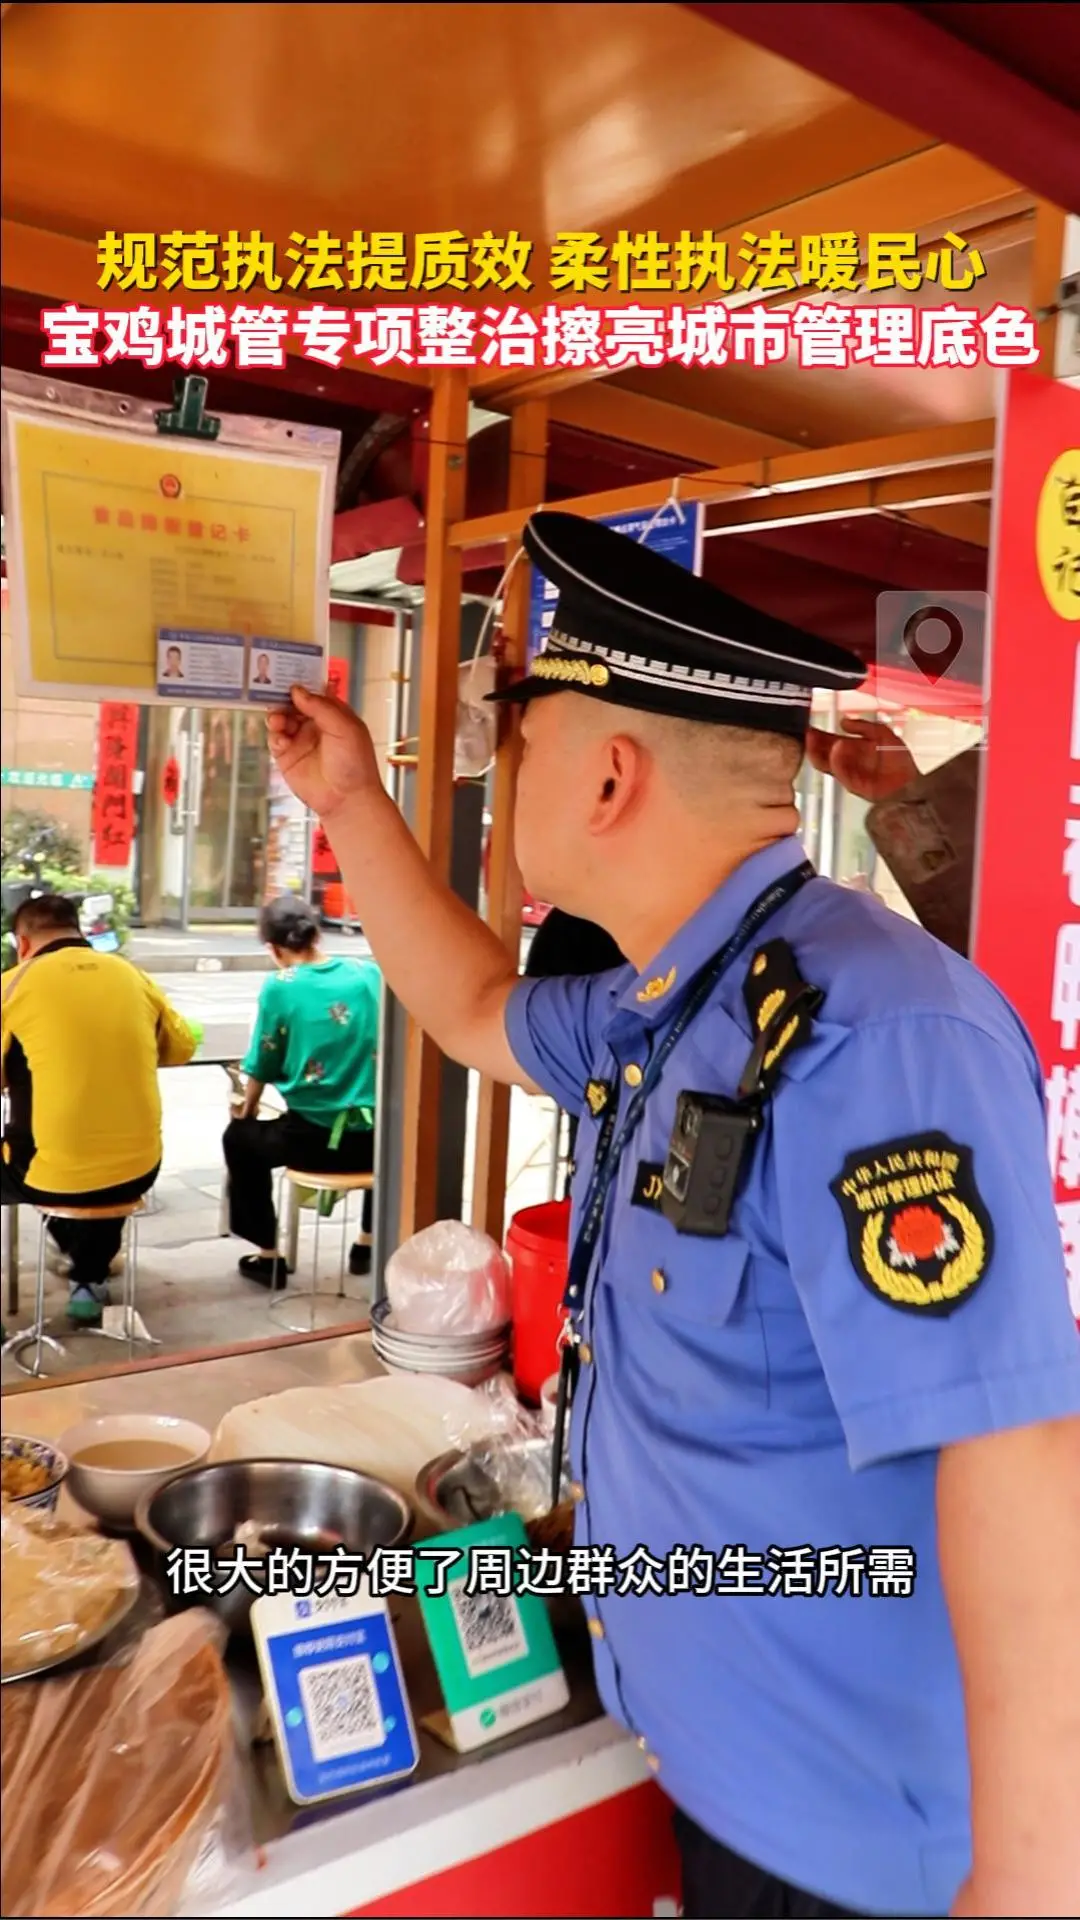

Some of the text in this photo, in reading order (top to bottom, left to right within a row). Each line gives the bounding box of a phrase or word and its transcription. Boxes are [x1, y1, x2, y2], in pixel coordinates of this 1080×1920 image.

[841, 1149, 960, 1197] 中华人民共和国
[856, 1168, 956, 1212] 城市管理执法
